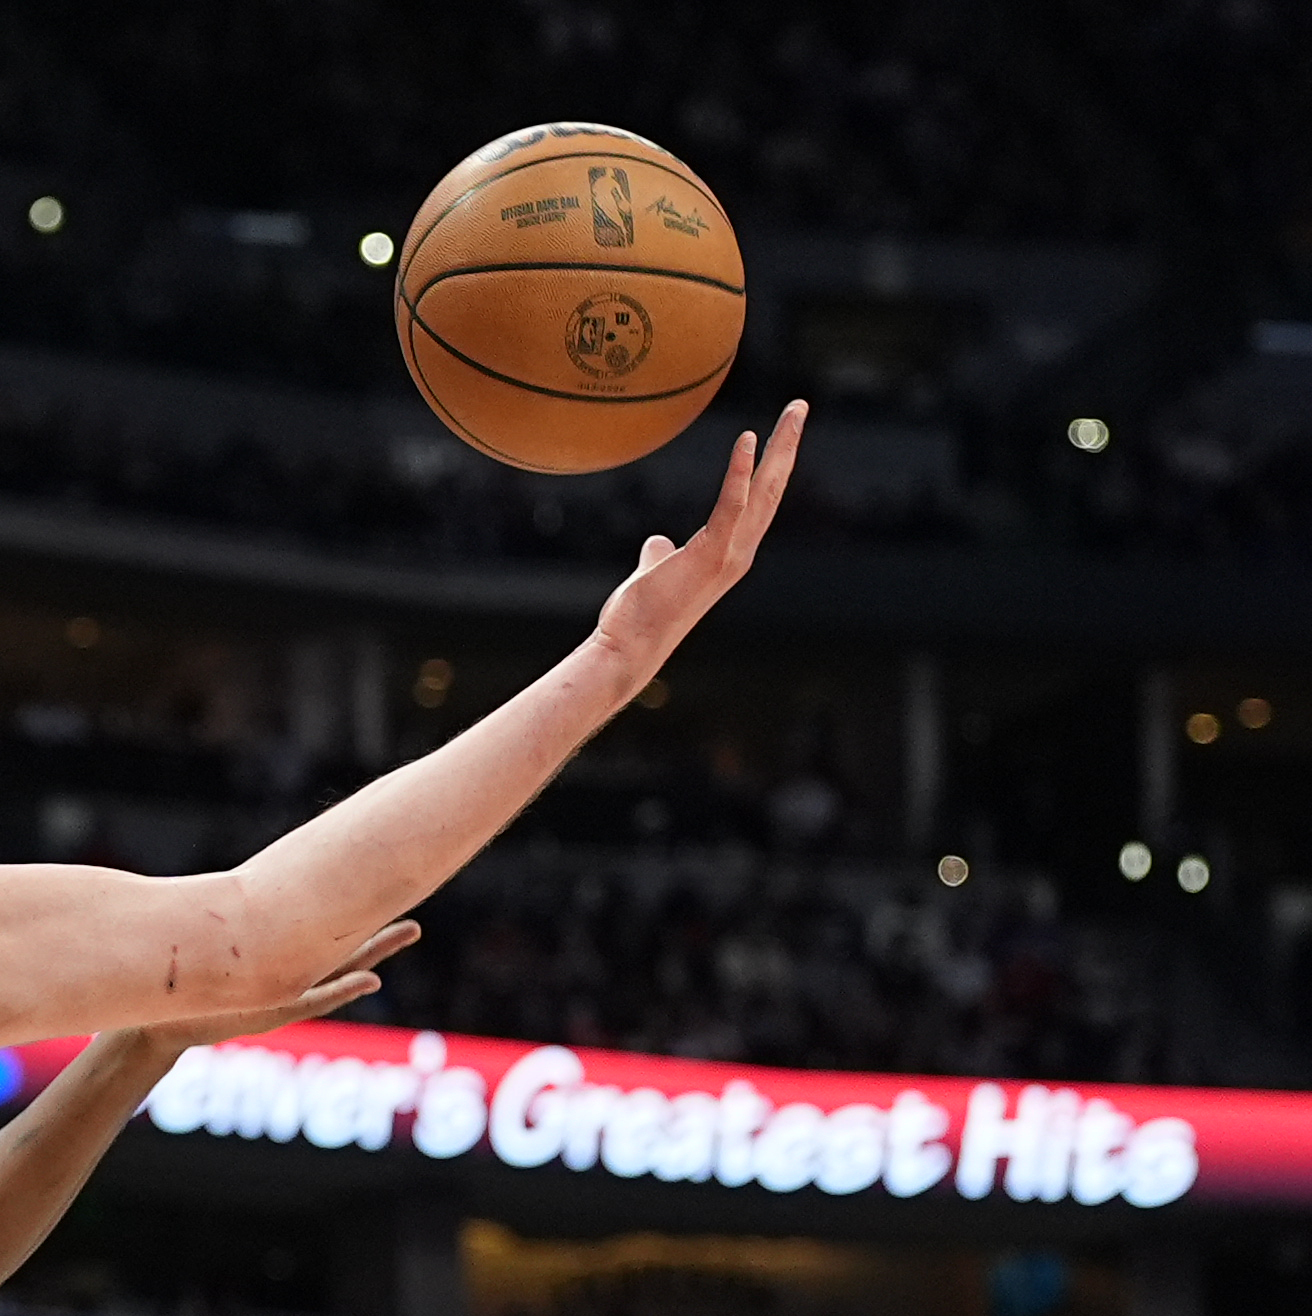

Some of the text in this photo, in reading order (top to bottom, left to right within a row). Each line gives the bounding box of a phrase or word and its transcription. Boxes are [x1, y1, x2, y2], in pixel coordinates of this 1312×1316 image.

[133, 1031, 487, 1159] enver's
[489, 1044, 953, 1198] Greatest
[955, 1080, 1199, 1208] Hits
